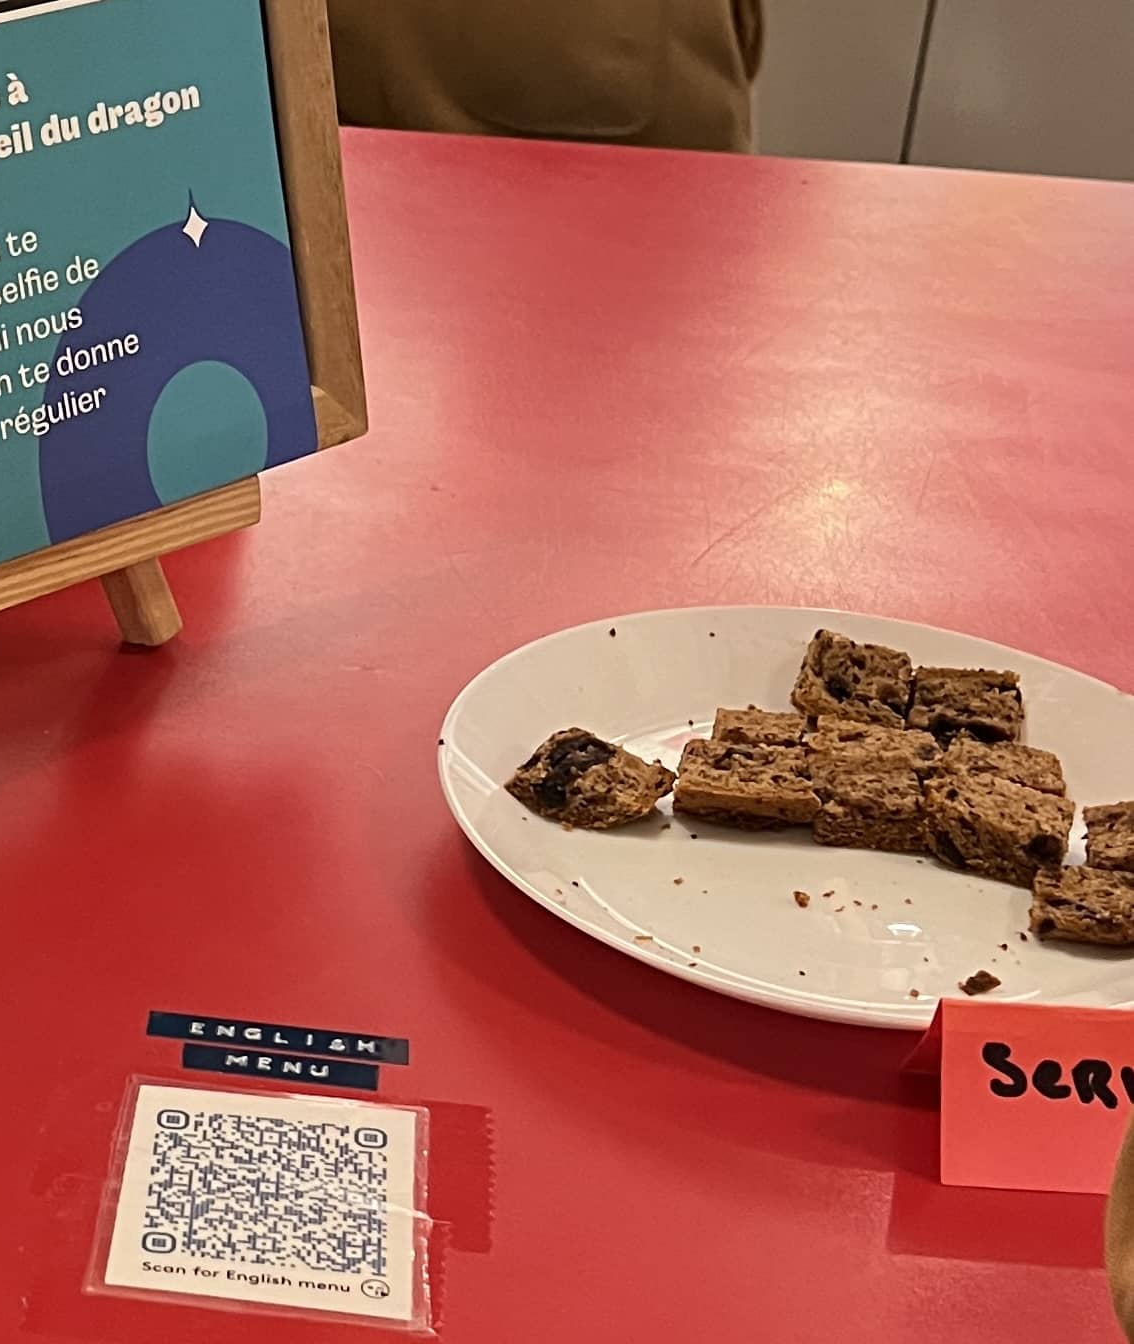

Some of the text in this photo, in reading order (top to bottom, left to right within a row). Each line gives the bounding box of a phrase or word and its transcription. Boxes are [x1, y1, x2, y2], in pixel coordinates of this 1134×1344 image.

[6, 72, 29, 106] à
[40, 113, 81, 147] du
[87, 85, 200, 135] dragon
[5, 229, 38, 256] te
[66, 254, 100, 285] de
[15, 307, 83, 346] nous
[18, 362, 50, 388] te
[56, 330, 140, 377] donne
[0, 387, 107, 440] régulier
[188, 1020, 381, 1055] ENGLISH
[225, 1053, 331, 1079] MENU
[141, 1260, 352, 1296] Scan for English menu
